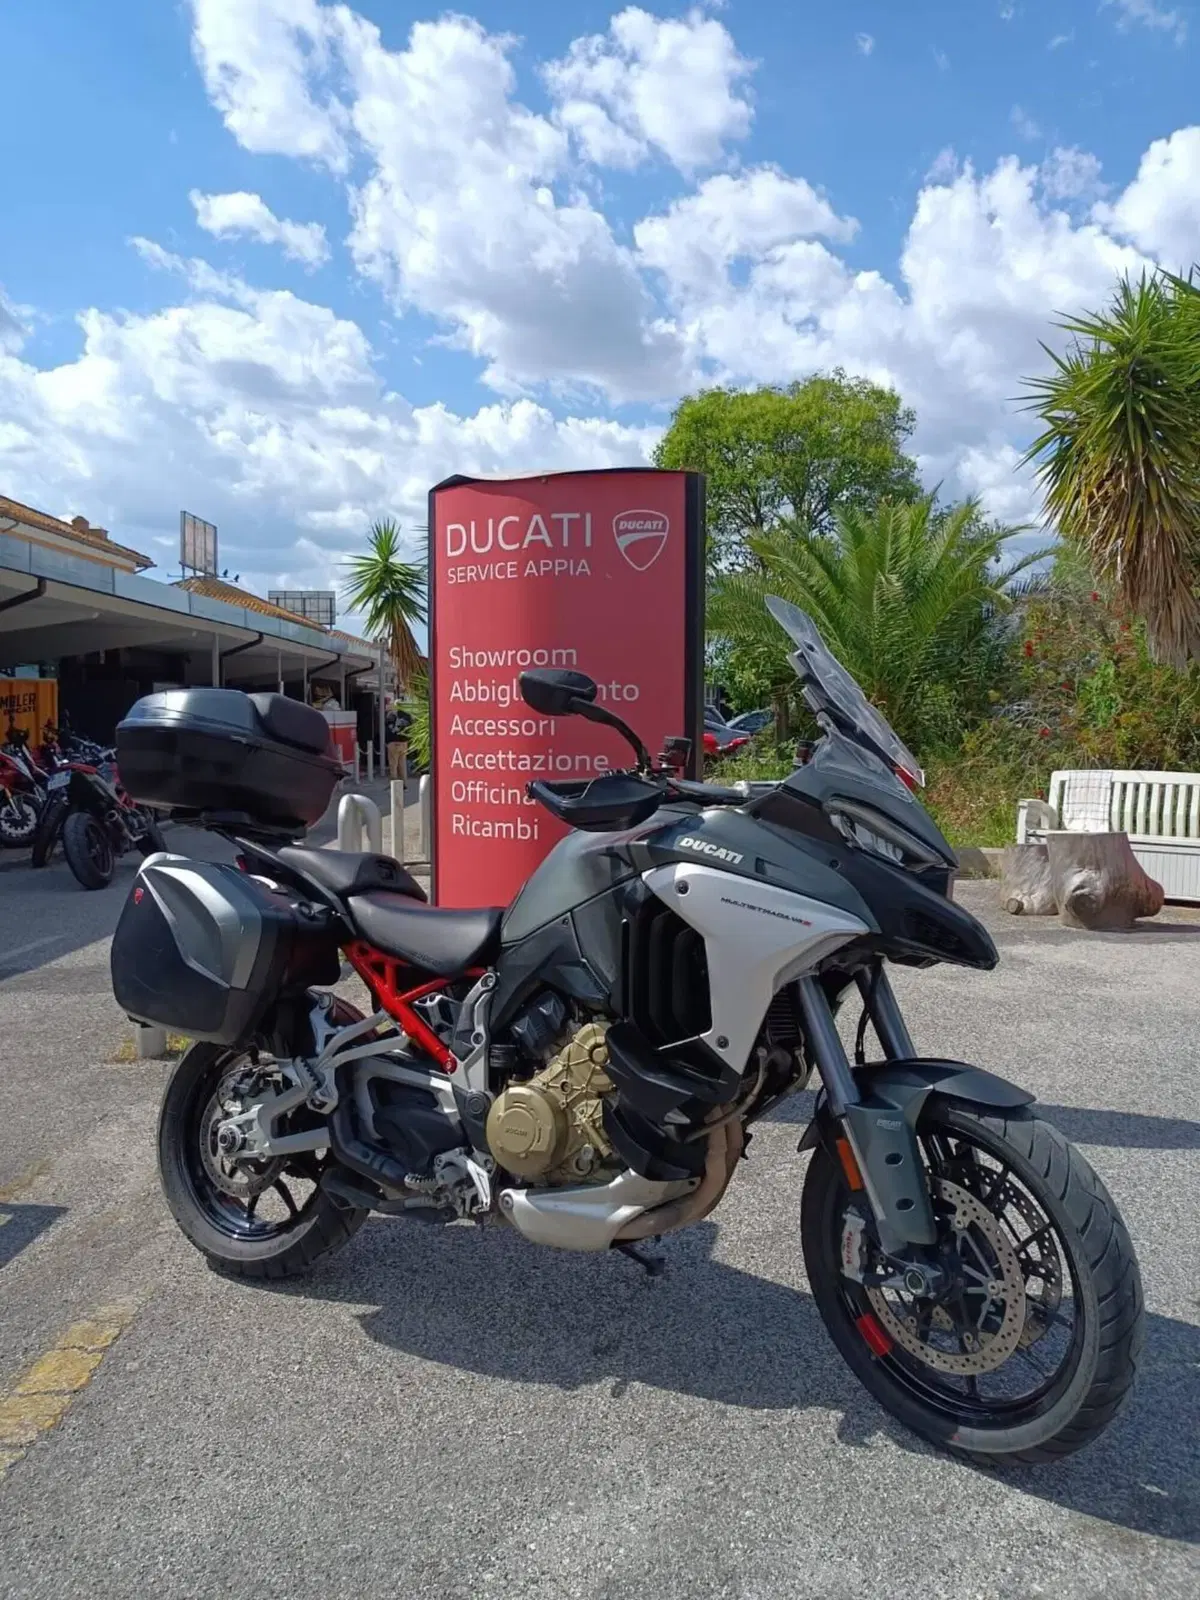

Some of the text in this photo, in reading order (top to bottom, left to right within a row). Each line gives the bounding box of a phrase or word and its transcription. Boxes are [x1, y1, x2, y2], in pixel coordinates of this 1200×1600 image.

[446, 512, 592, 557] DUCATI
[618, 520, 665, 530] DUCATI
[447, 559, 591, 584] SERVICE APPIA
[449, 646, 577, 668] Showroom
[450, 679, 640, 707] Abbiglnto
[450, 715, 555, 736] Accessori
[450, 748, 609, 771] Accettazione
[452, 814, 539, 840] Ricambi
[679, 837, 744, 865] DUCATI
